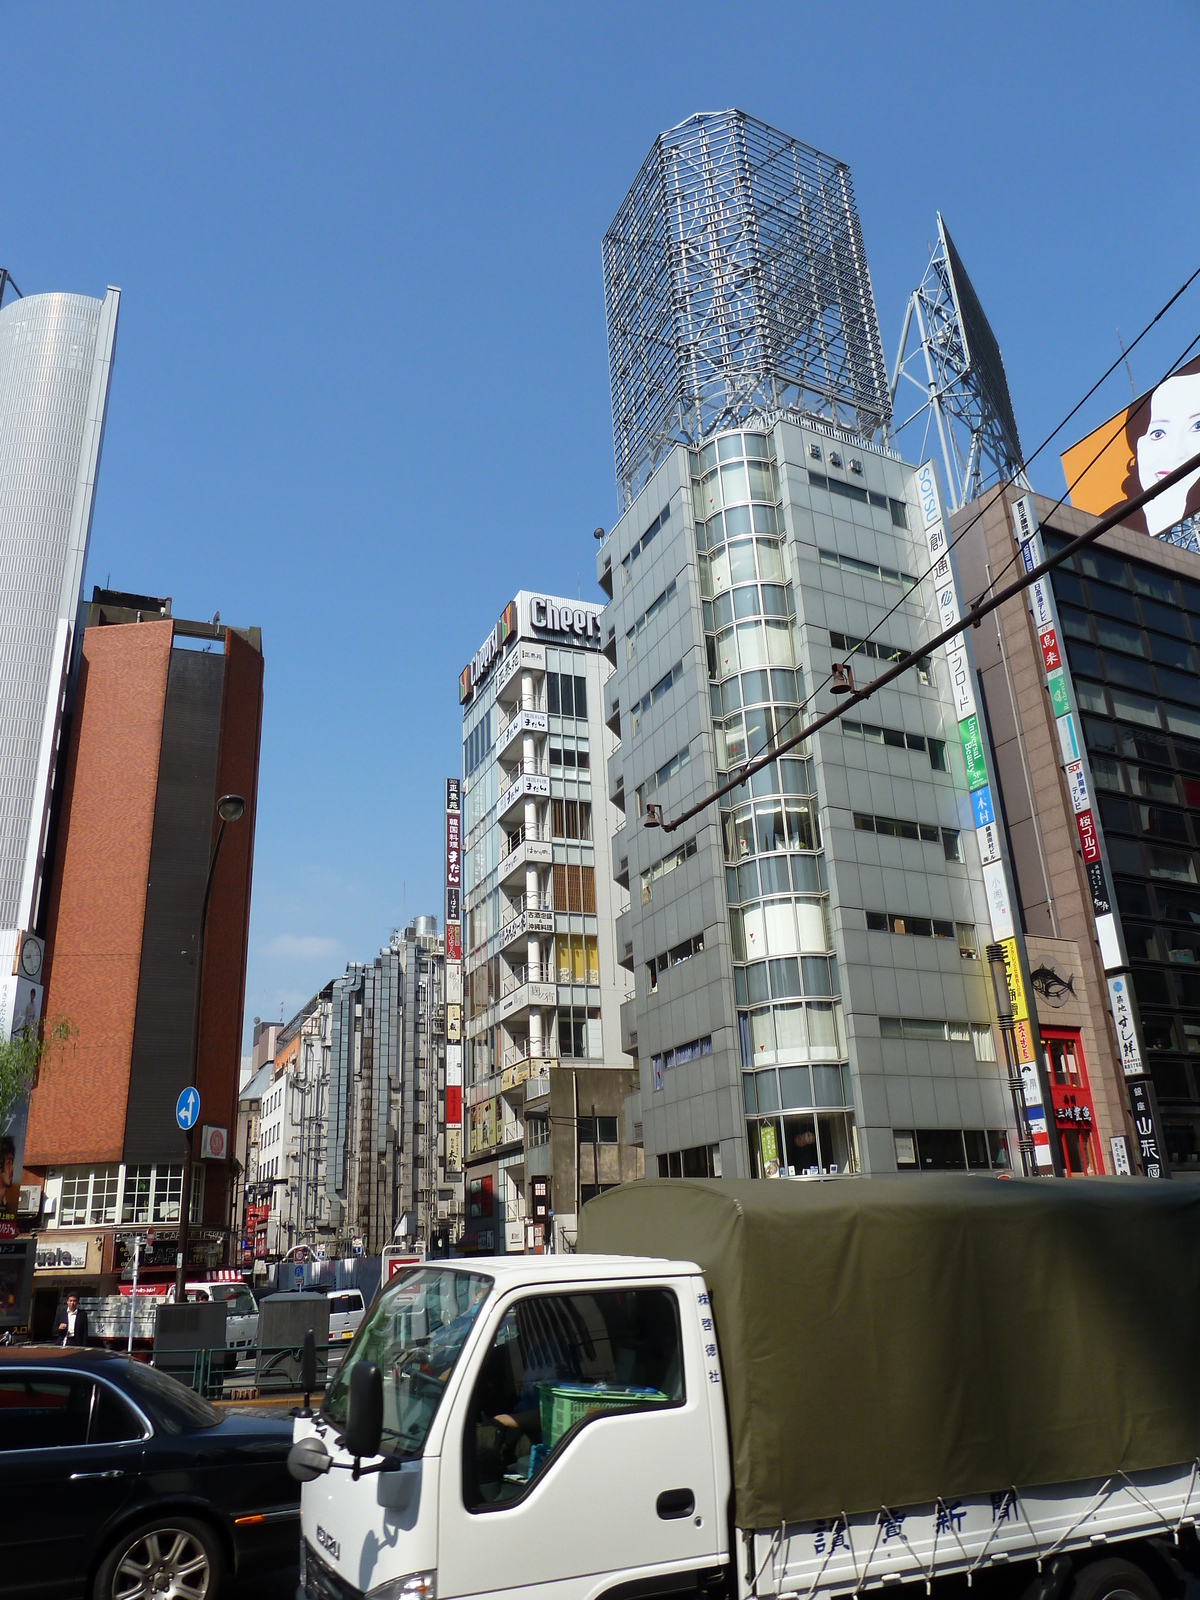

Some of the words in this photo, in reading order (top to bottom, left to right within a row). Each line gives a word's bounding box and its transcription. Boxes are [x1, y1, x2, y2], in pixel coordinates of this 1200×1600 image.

[919, 467, 938, 523] SOTSU
[929, 529, 949, 580] 創通
[967, 717, 981, 760] Universal
[965, 742, 975, 774] Beauty
[977, 797, 990, 824] 木村
[449, 818, 459, 849] 韓国料理
[1134, 1087, 1146, 1112] 銀座
[12, 1326, 28, 1335] 入口
